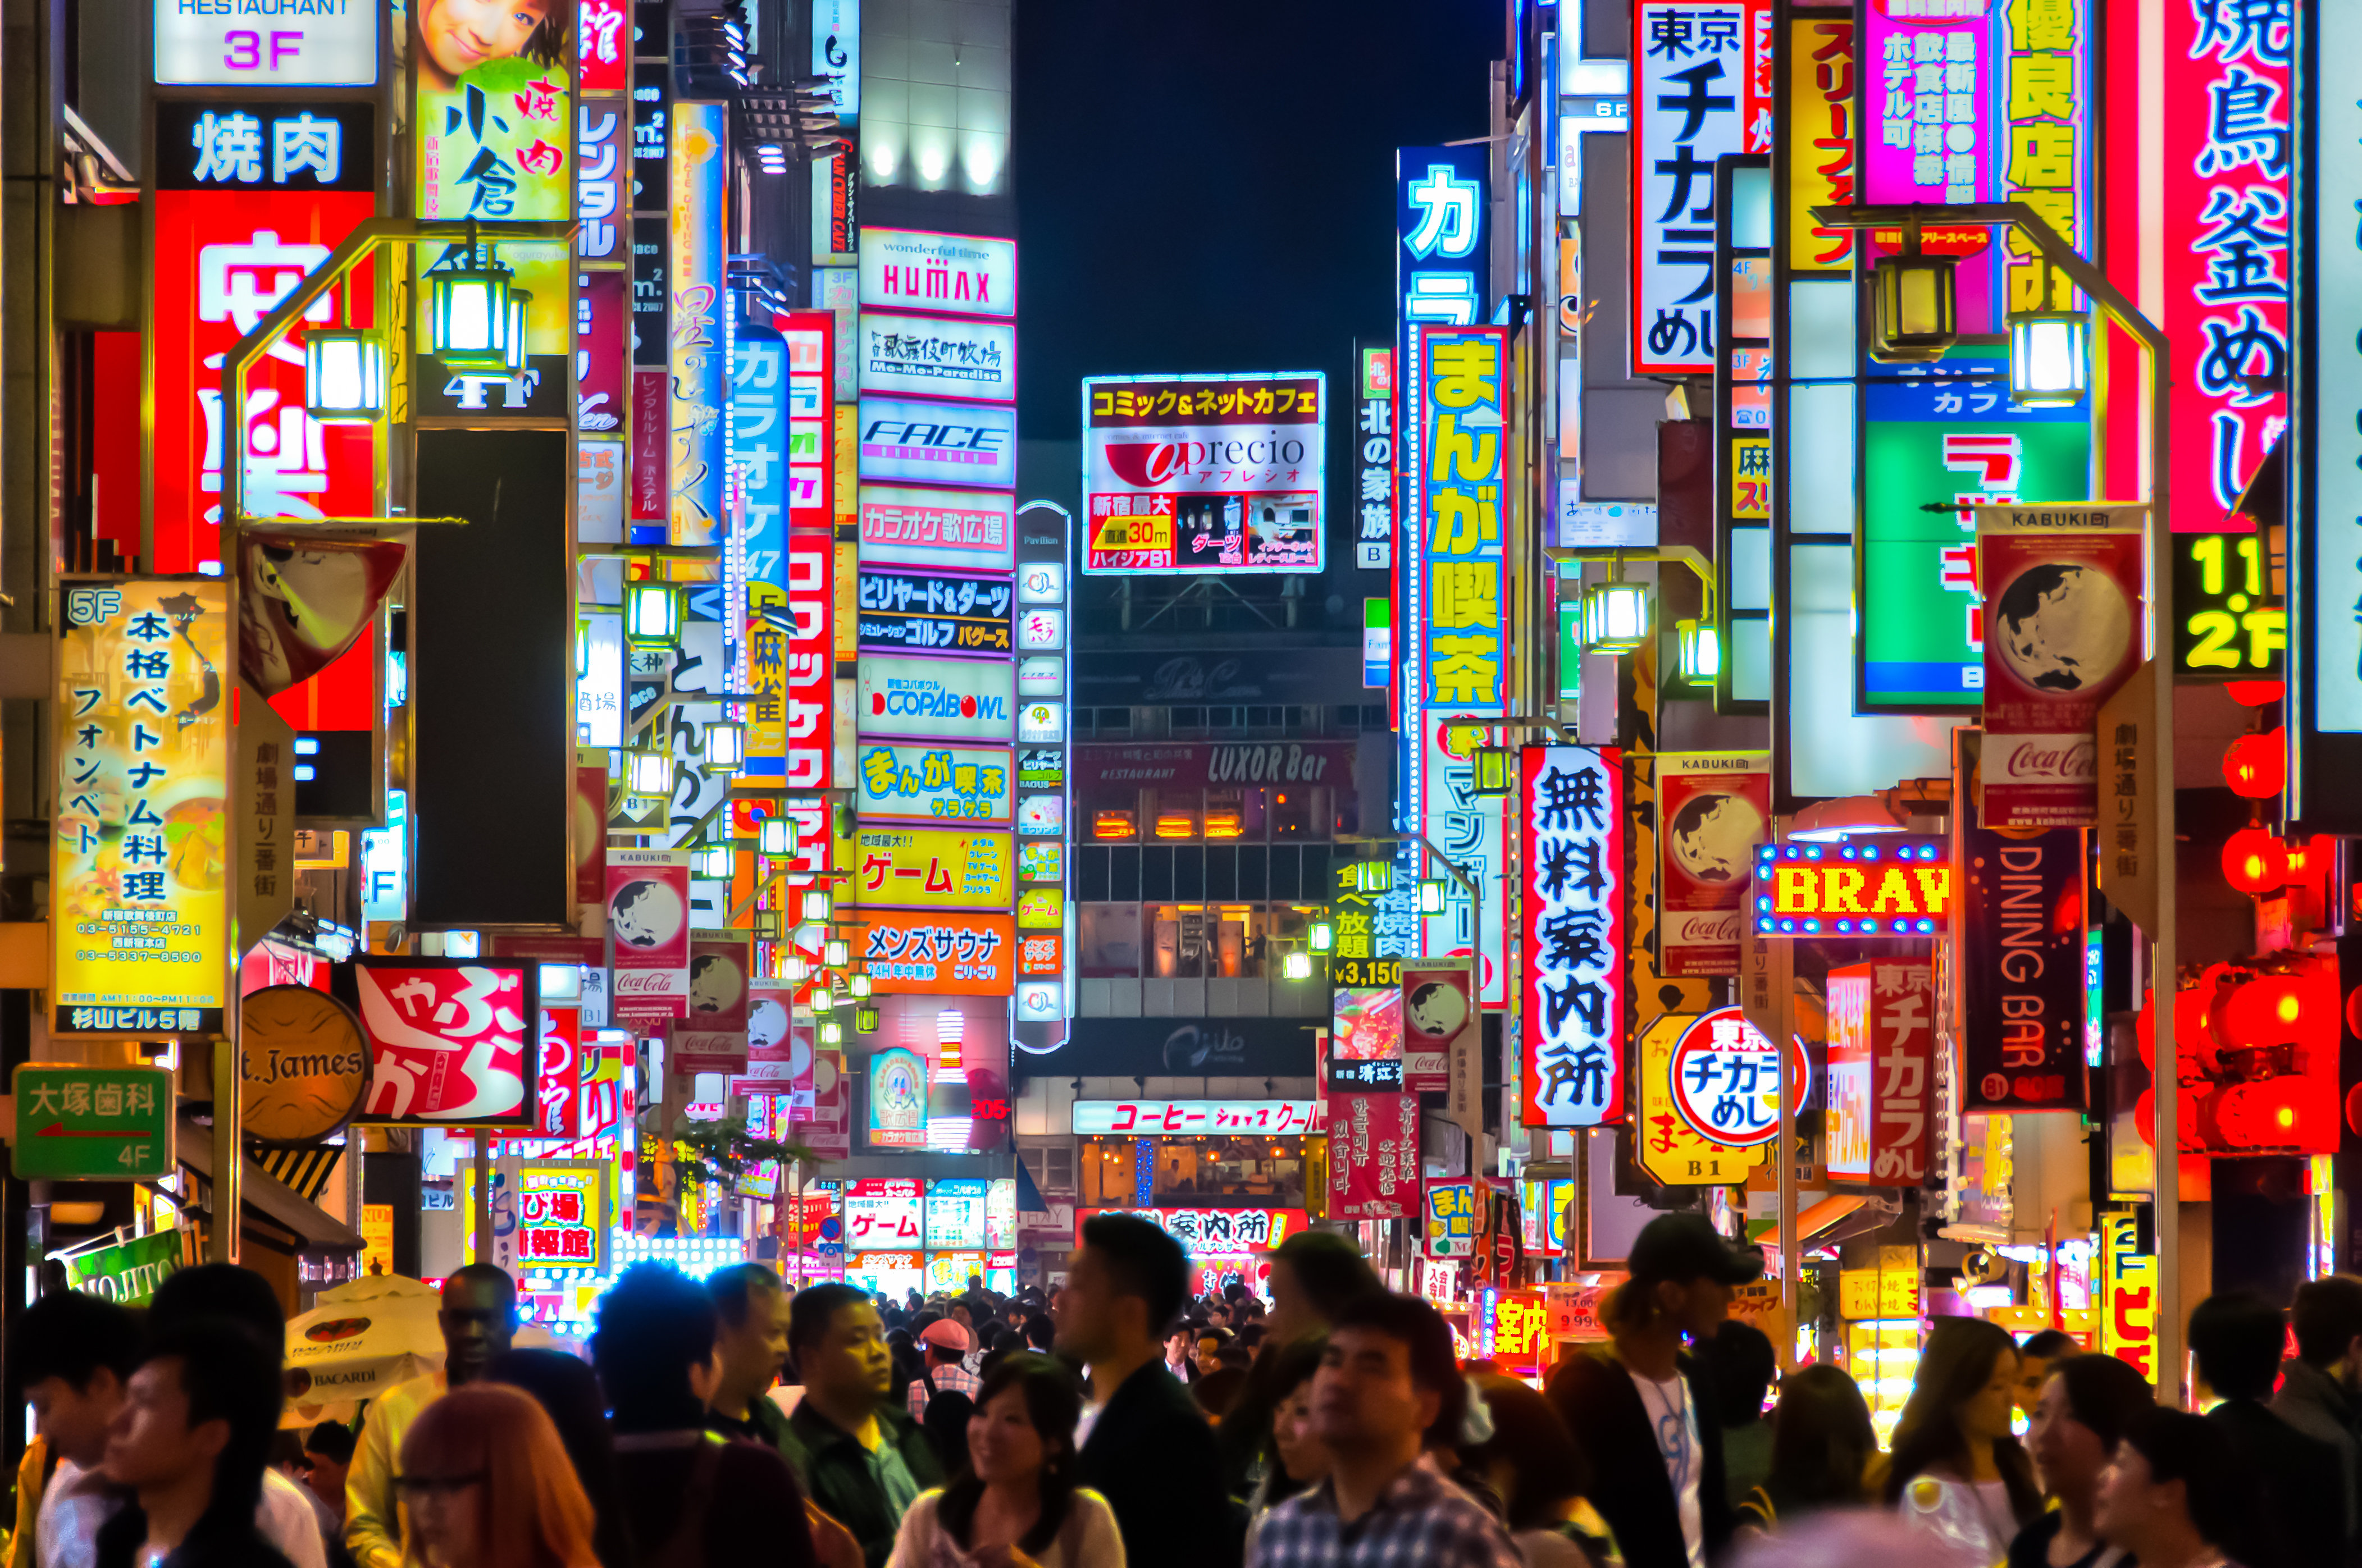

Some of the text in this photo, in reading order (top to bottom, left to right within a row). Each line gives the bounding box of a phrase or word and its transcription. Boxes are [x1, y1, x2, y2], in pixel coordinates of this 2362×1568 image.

[224, 30, 304, 71] 3F
[1647, 8, 1741, 61] 東京
[1882, 32, 1913, 150] ホテル可
[1595, 101, 1627, 116] 6F
[1913, 33, 1944, 186] 飲食店検索
[514, 77, 563, 176] 焼肉
[193, 111, 341, 183] 焼肉
[579, 106, 615, 256] レンタル
[1654, 58, 1726, 304] チカラ
[883, 243, 990, 260] wonderful time
[1733, 261, 1752, 275] 4F
[883, 258, 990, 303] HUMAX
[872, 361, 1001, 382] Mo-Mo-Paradise
[1733, 355, 1750, 368] 3F
[1094, 387, 1316, 417] コミック&ネットカフェ
[733, 341, 781, 540] カラオケ
[863, 420, 1010, 451] FACE
[882, 446, 979, 464] SHINJUKU
[1146, 430, 1305, 483] aprecio
[1360, 400, 1390, 539] 北の家族
[1199, 469, 1299, 484] アプレシオ
[1093, 496, 1171, 516] 新宿最大
[1432, 340, 1497, 703] まんが喫茶
[865, 508, 1003, 545] カラオケ歌広場
[1191, 533, 1242, 554] ダーツ
[1093, 549, 1172, 568] ハイジアB1
[69, 590, 121, 623] 5F
[859, 577, 1010, 618] ビリヤード&ダーツ
[2186, 611, 2288, 669] 2F
[579, 691, 617, 712] 酒場
[70, 689, 103, 853] フォンベト
[124, 612, 171, 900] 本格ベトナム料理
[861, 747, 1005, 796] まんが喫茶
[1207, 744, 1327, 784] LUXOR Bar
[1101, 768, 1176, 780] RESTAURANT
[254, 742, 279, 898] 劇場通り一番街
[930, 798, 992, 819] ケラケラ
[860, 834, 914, 848] 地域最大!!
[862, 853, 954, 894] ゲーム
[1020, 904, 1059, 917] ゲーム
[1999, 846, 2045, 984] DINING
[76, 924, 202, 936] 03-5155-4721
[112, 937, 167, 949] 西新宿本店
[865, 925, 1001, 963] メンズサウナ
[1024, 940, 1056, 950] メンズ
[1540, 765, 1609, 1107] 無料案内所
[76, 950, 202, 963] 03-5337-8590
[1334, 962, 1401, 987] ¥3,150
[1874, 964, 1932, 997] 東京
[72, 1008, 202, 1031] 杉山ビル5階
[1711, 1019, 1773, 1052] 東京
[2001, 995, 2045, 1068] BAR
[240, 1049, 364, 1085] t.James
[1685, 1053, 1780, 1094] チカラ
[1879, 996, 1930, 1149] チカラ
[29, 1082, 156, 1117] 大塚歯科
[1712, 1094, 1772, 1128] めし
[880, 1109, 918, 1127] 歌広場
[1110, 1104, 1206, 1131] コーヒー
[1351, 1098, 1370, 1168] 한글메뉴
[118, 1145, 151, 1167] 4F
[1333, 1121, 1350, 1195] 있습니다
[1873, 1149, 1925, 1180] めし
[522, 1192, 582, 1224] び場
[852, 1213, 920, 1238] ゲーム
[519, 1229, 592, 1258] 報館
[1494, 1299, 1550, 1354] 案内
